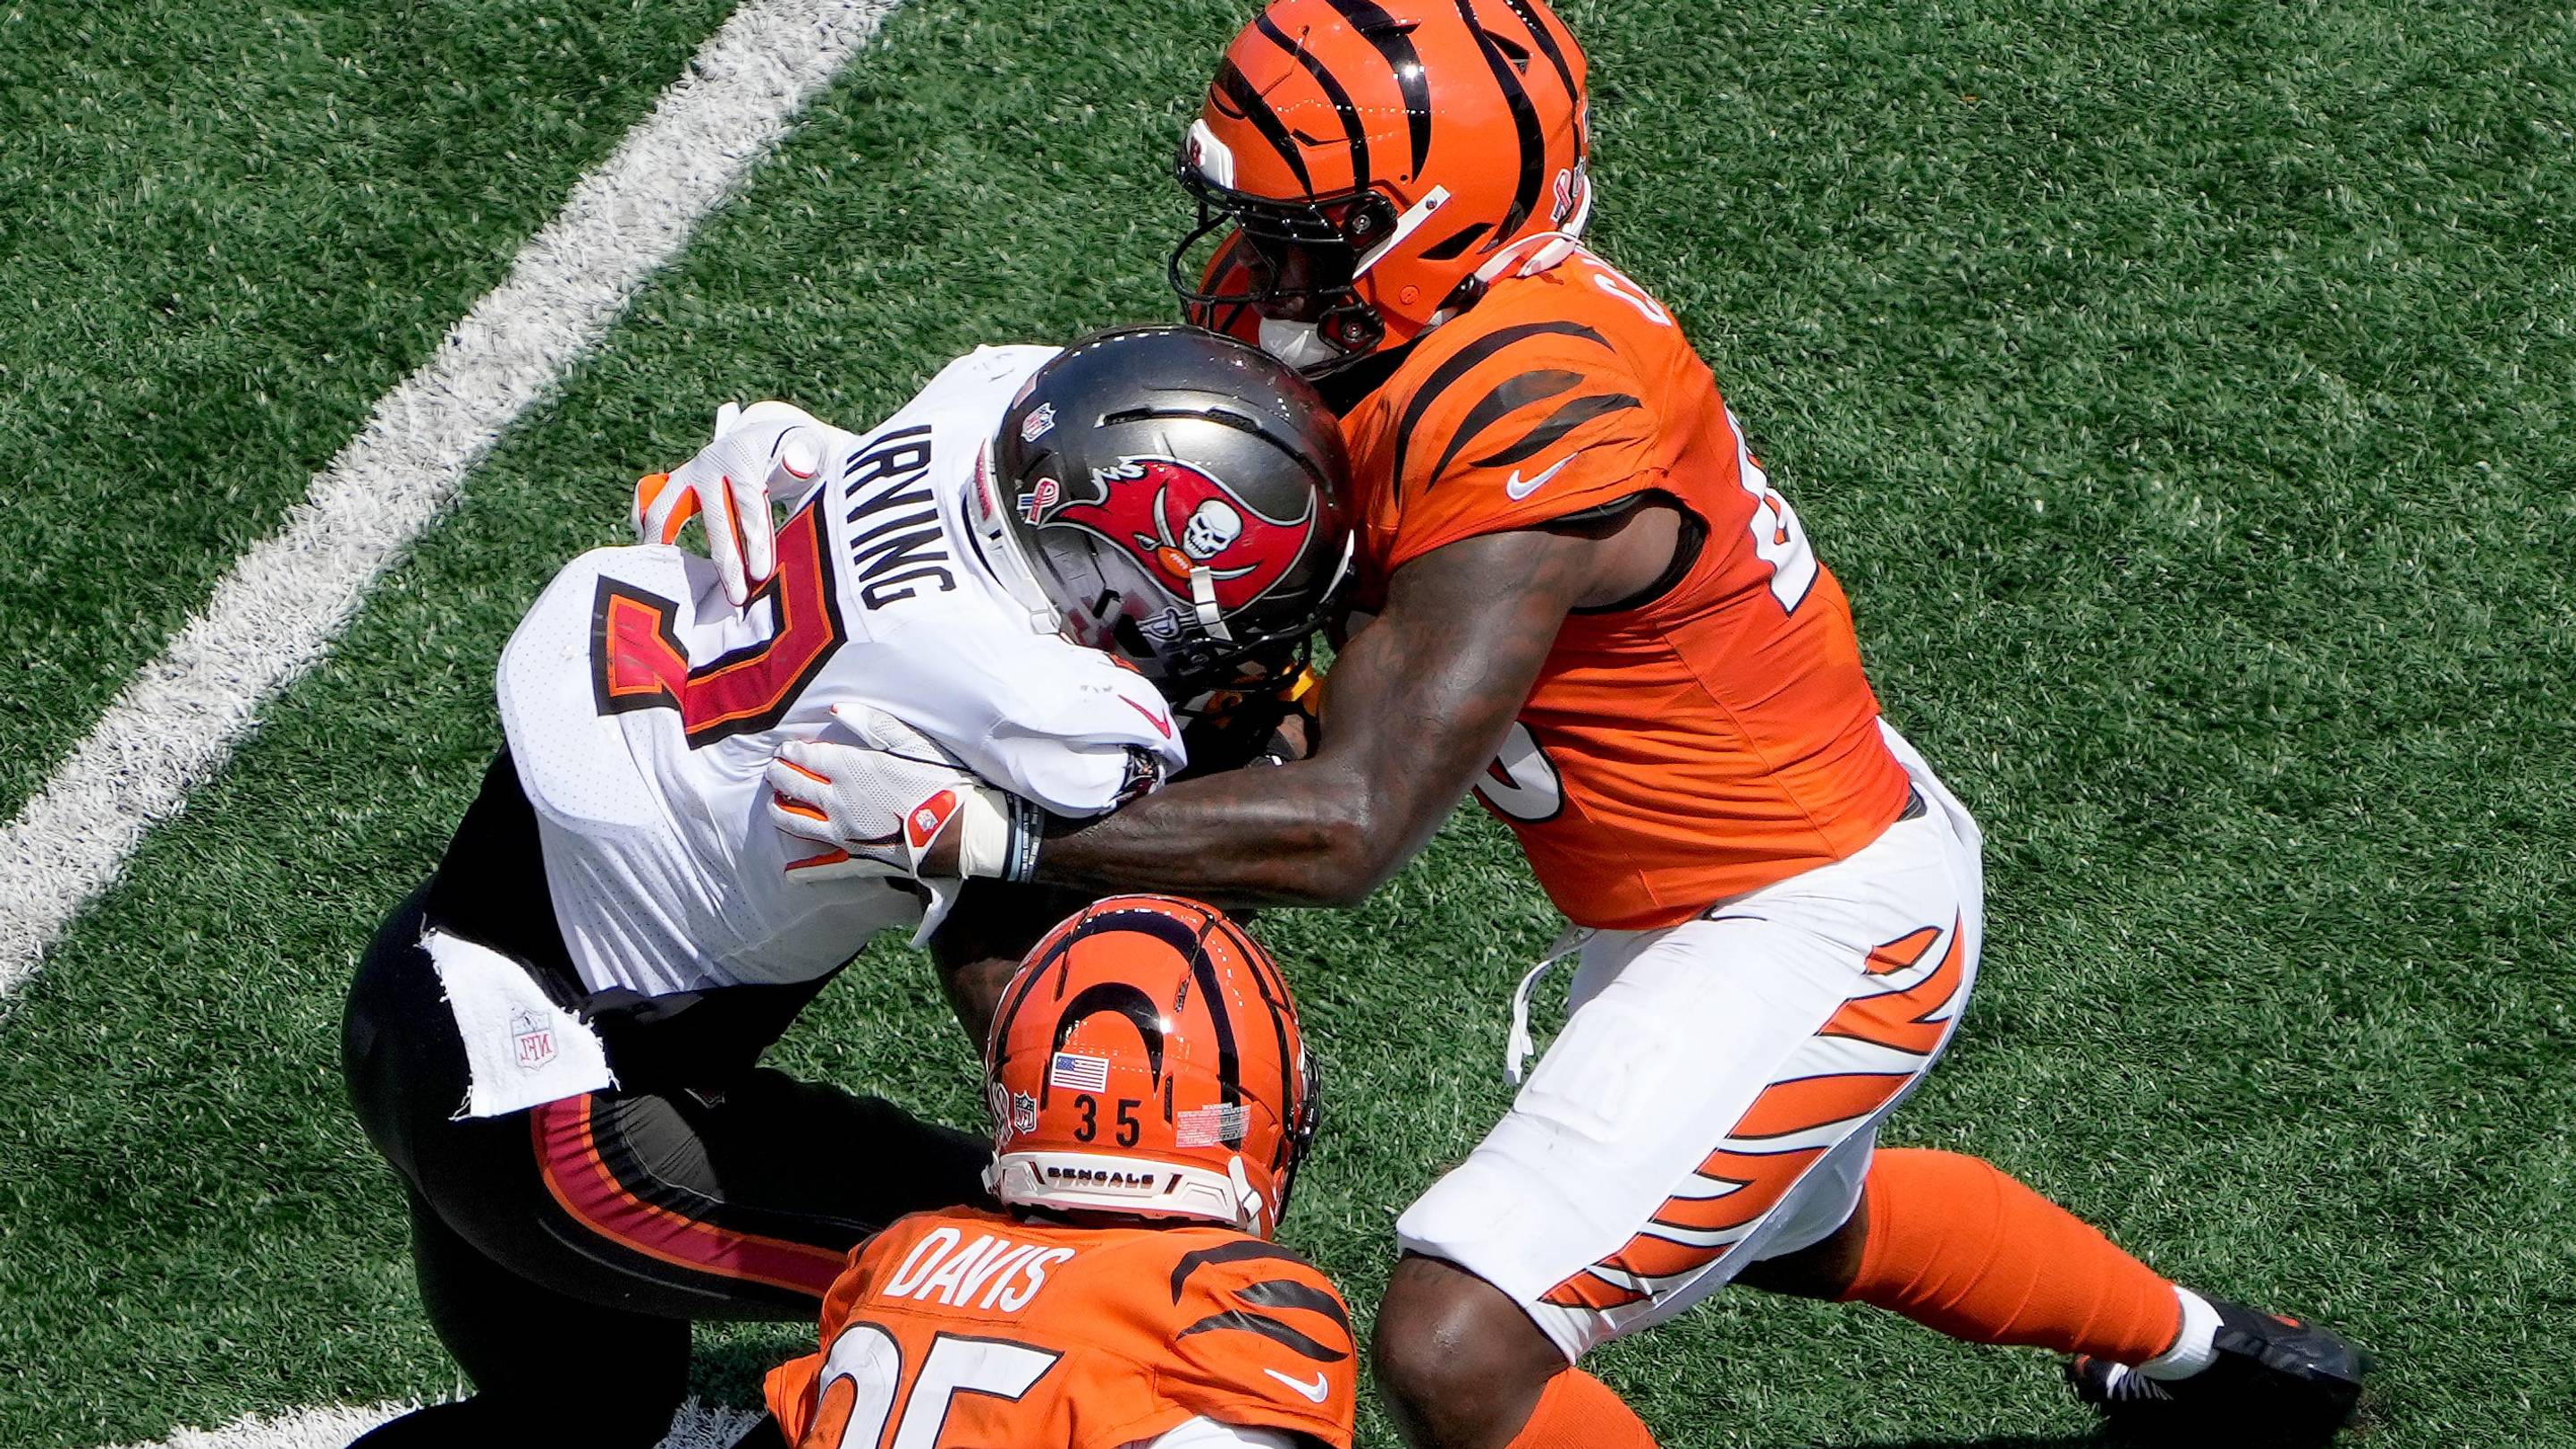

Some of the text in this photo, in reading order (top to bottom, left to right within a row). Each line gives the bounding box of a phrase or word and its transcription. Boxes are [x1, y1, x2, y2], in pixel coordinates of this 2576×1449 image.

[843, 425, 956, 610] IRVING
[590, 480, 848, 750] 7
[1047, 1167, 1154, 1186] BENGALS
[883, 1227, 1076, 1312] DAVIS
